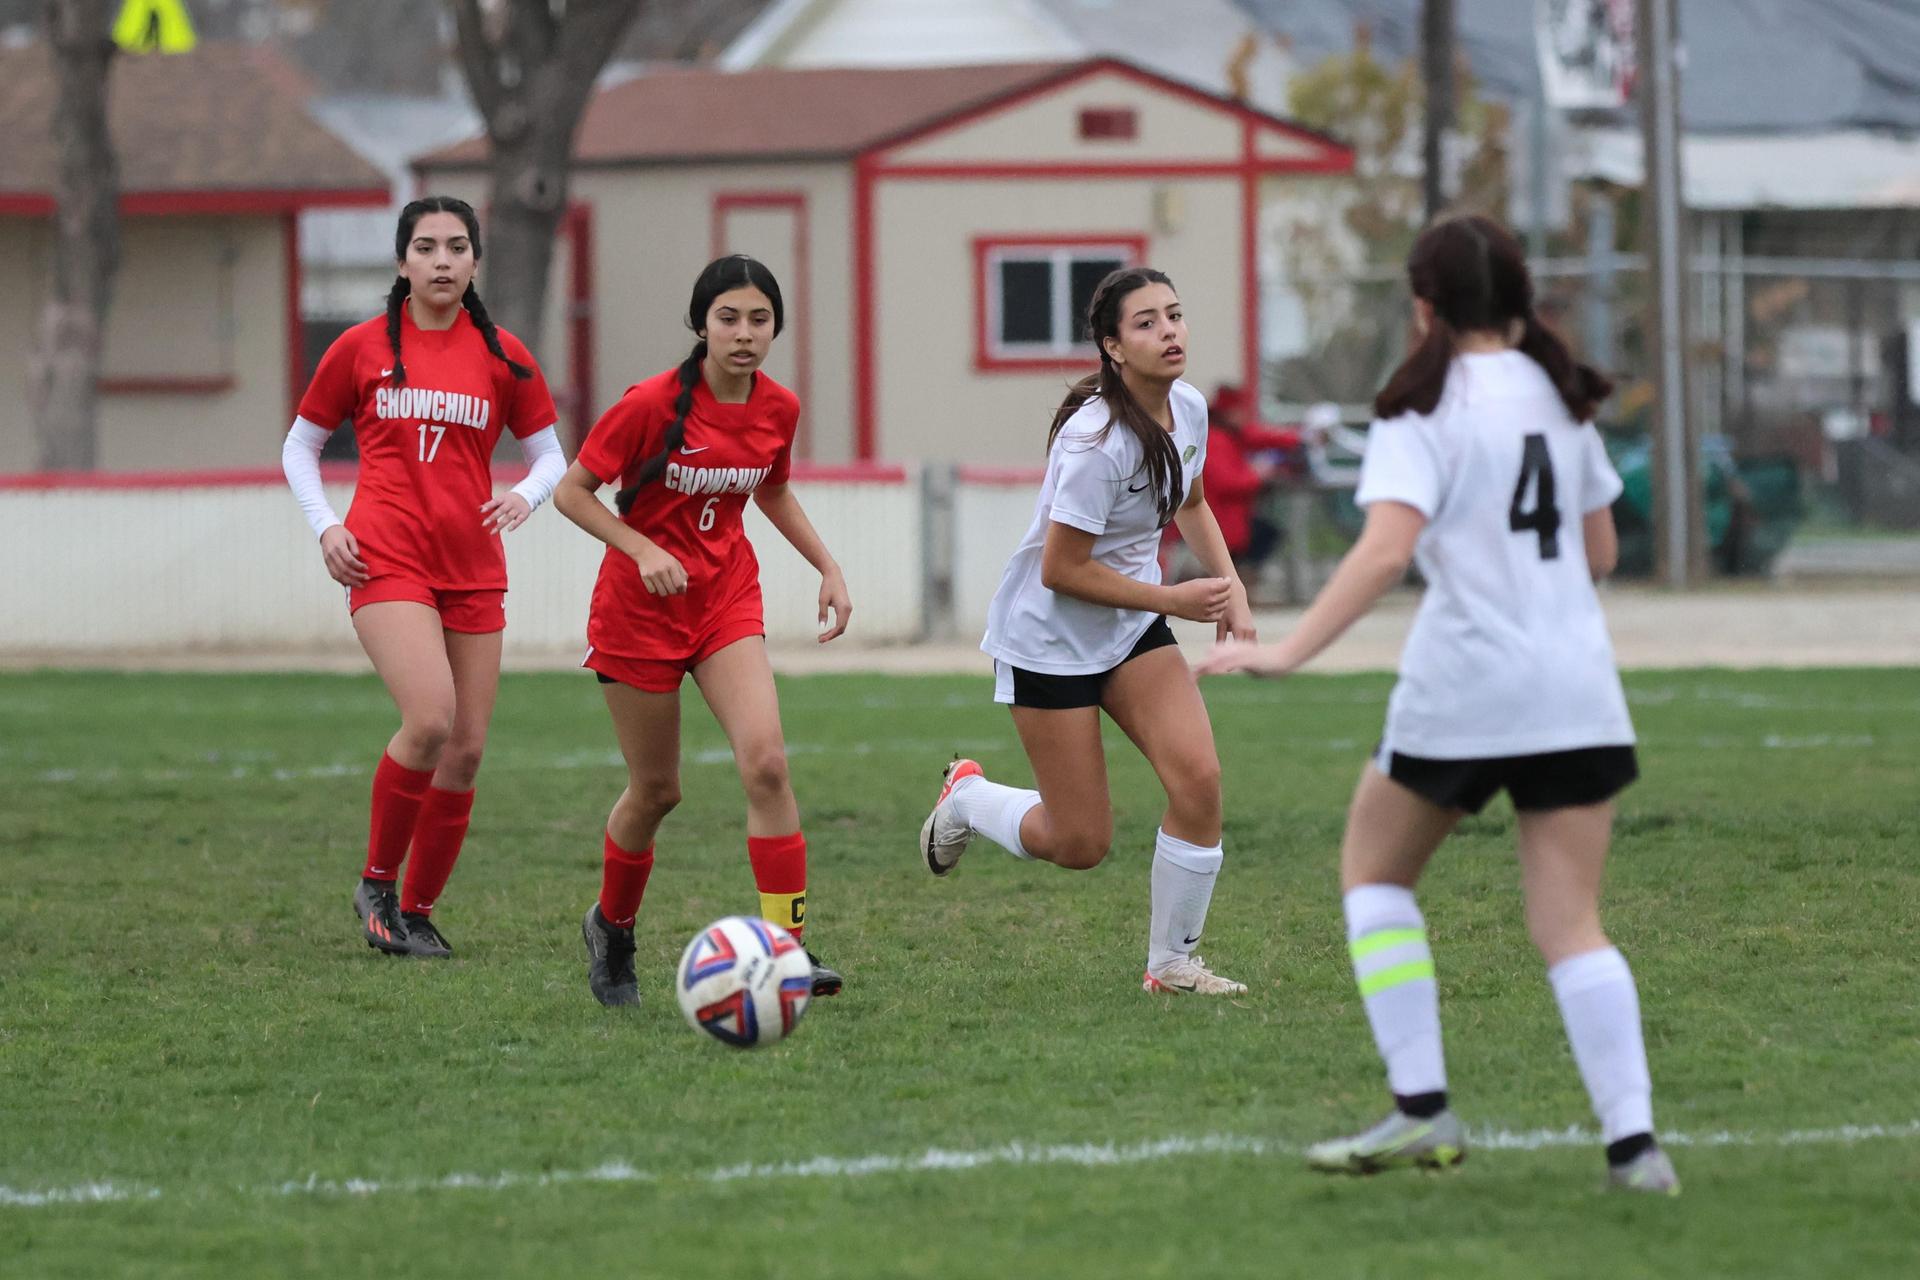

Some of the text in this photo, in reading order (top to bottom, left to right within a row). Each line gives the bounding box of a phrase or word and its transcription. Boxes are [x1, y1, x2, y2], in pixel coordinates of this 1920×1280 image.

[376, 387, 489, 430] CHOWCHILLA
[417, 424, 446, 463] 17
[665, 462, 772, 496] CHOWCHIL
[1510, 434, 1561, 560] 4
[698, 497, 720, 531] 6
[791, 897, 805, 924] C
